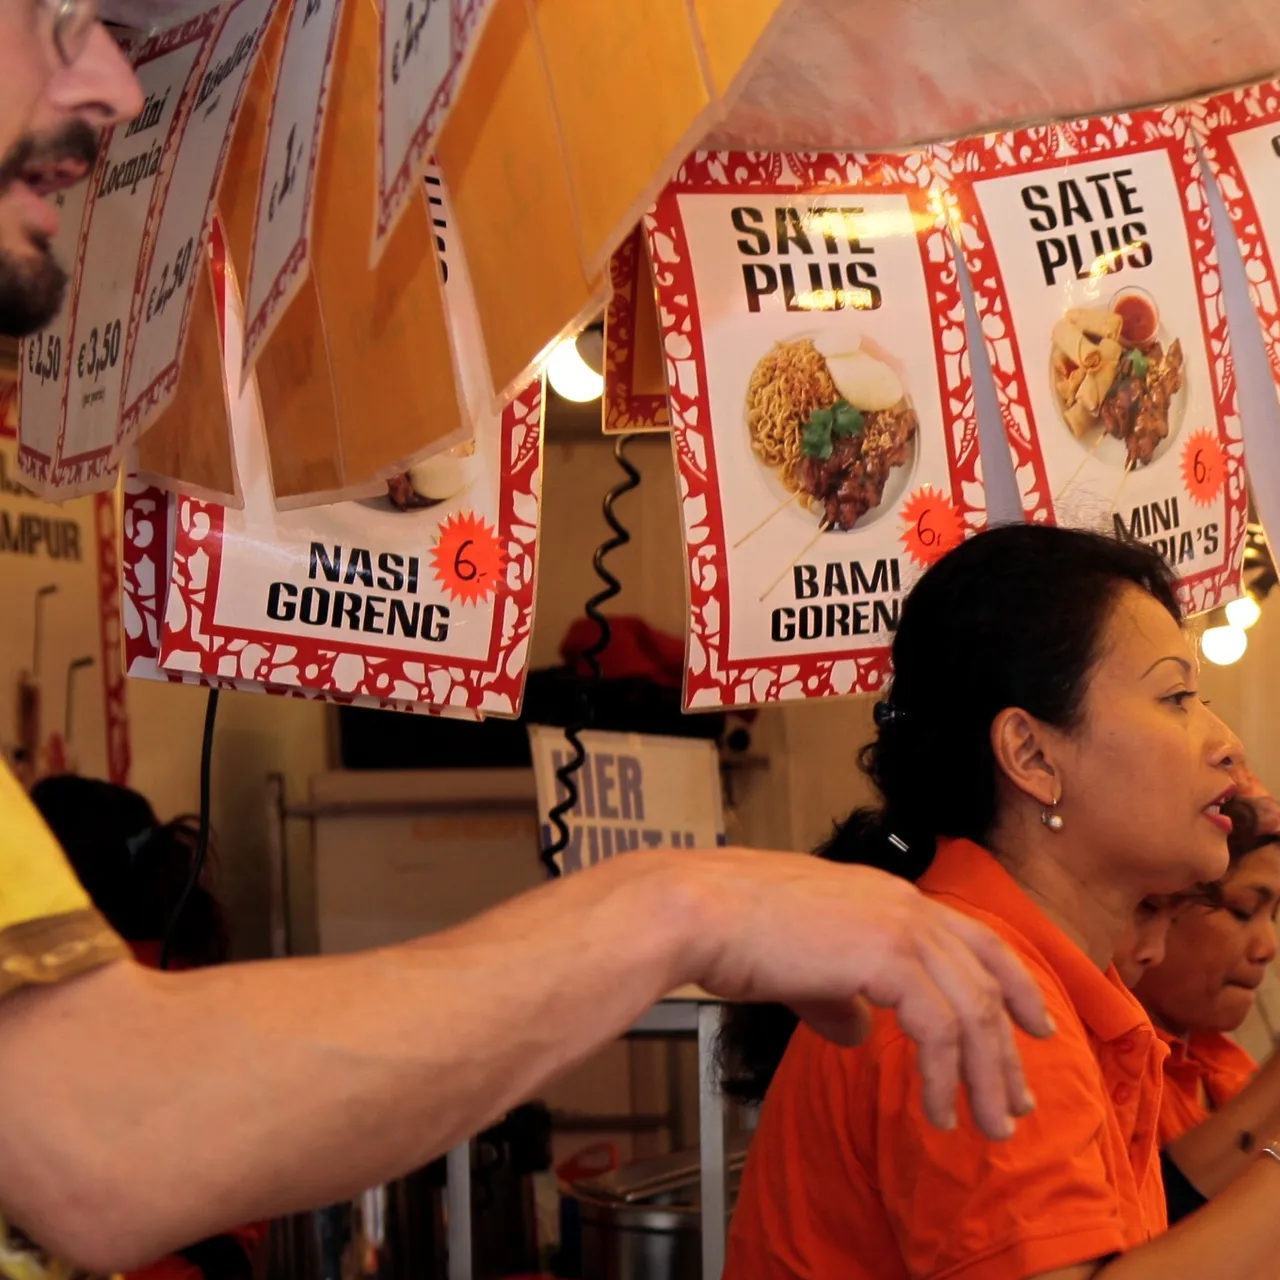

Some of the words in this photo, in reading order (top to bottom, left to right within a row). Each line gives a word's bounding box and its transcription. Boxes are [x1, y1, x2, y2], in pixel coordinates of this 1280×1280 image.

[1020, 168, 1144, 233] SATE
[730, 206, 876, 257] SATE
[1035, 221, 1153, 287] PLUS
[741, 261, 883, 314] PLUS
[87, 318, 121, 383] 3,50
[1112, 496, 1181, 546] MINI
[308, 541, 420, 595] NASI
[793, 558, 901, 601] BAMI
[266, 581, 451, 643] GORENG
[770, 598, 902, 643] GOREN
[551, 748, 645, 821] HIER
